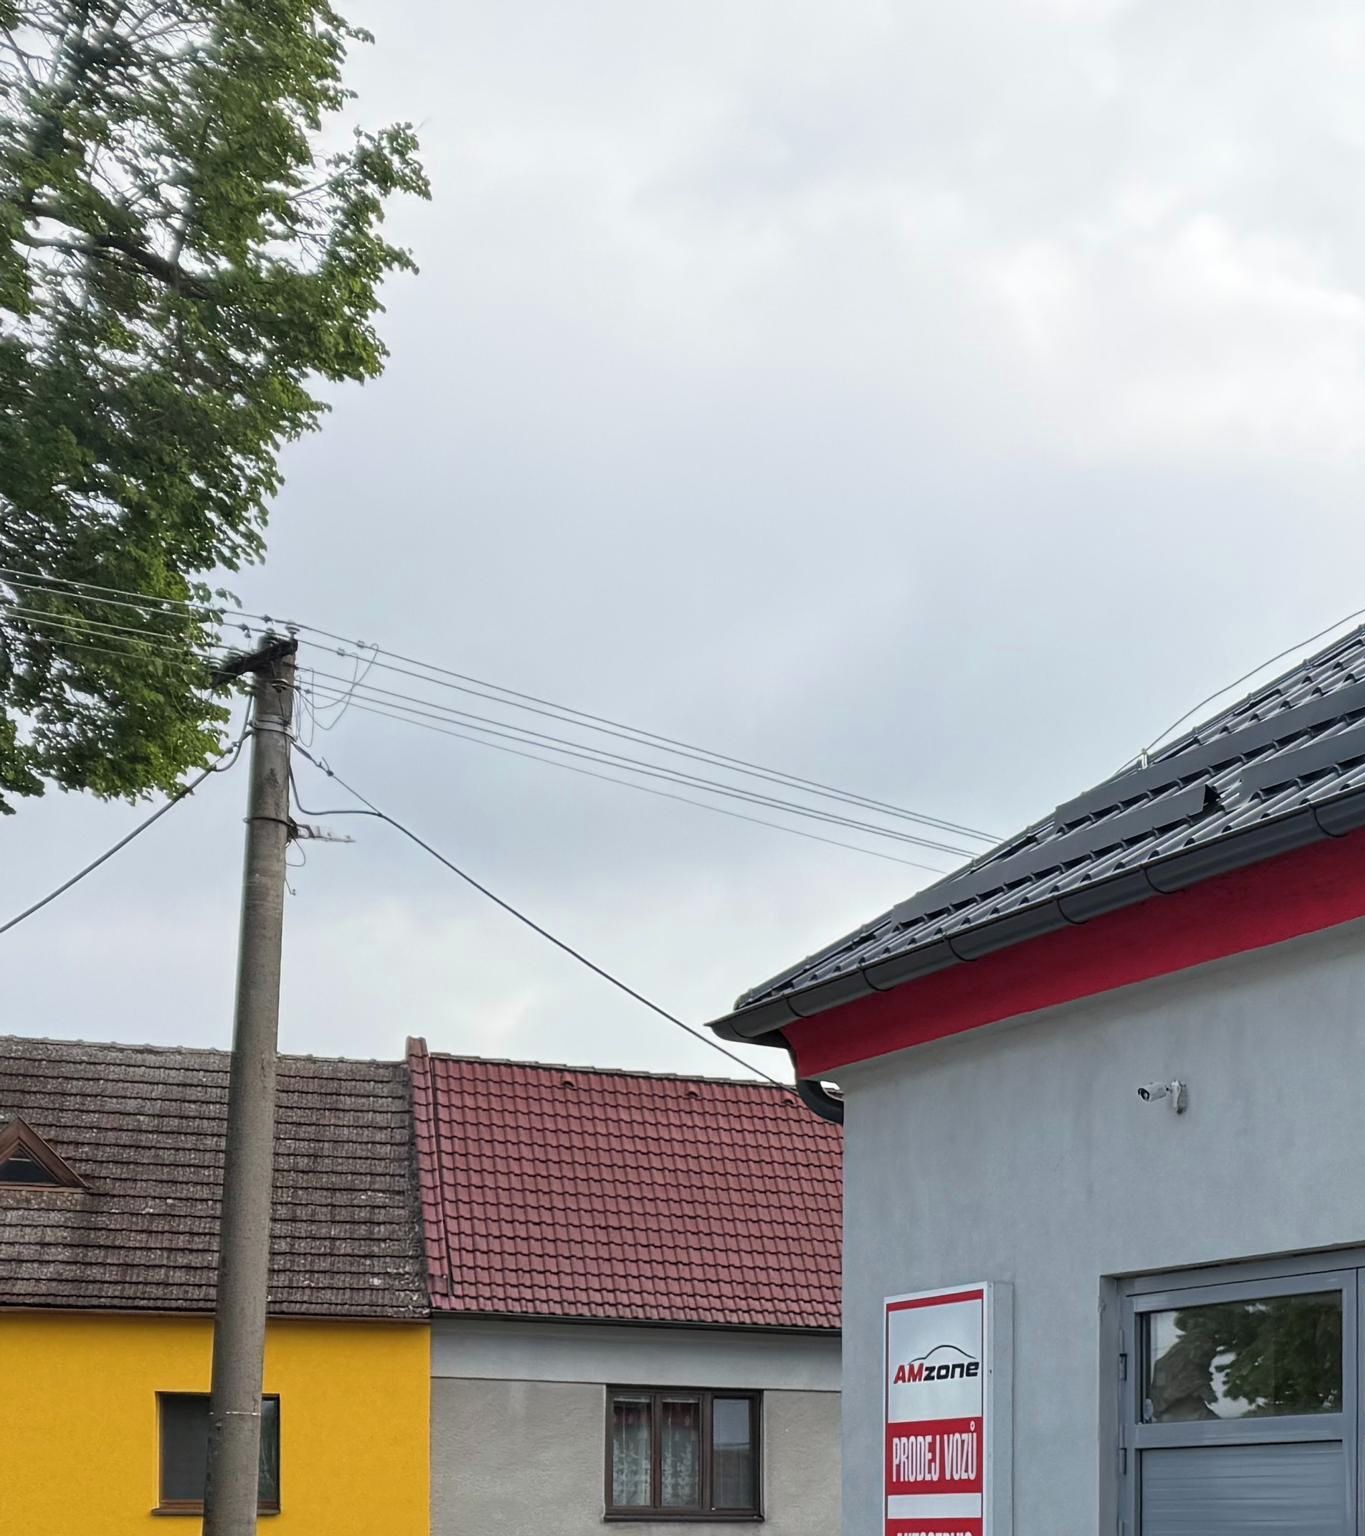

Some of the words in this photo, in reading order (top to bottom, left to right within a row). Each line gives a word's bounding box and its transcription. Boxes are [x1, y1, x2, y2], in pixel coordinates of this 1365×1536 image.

[893, 1361, 980, 1385] AMzone
[892, 1433, 941, 1483] PRODEJ
[944, 1420, 977, 1482] VOZŮ
